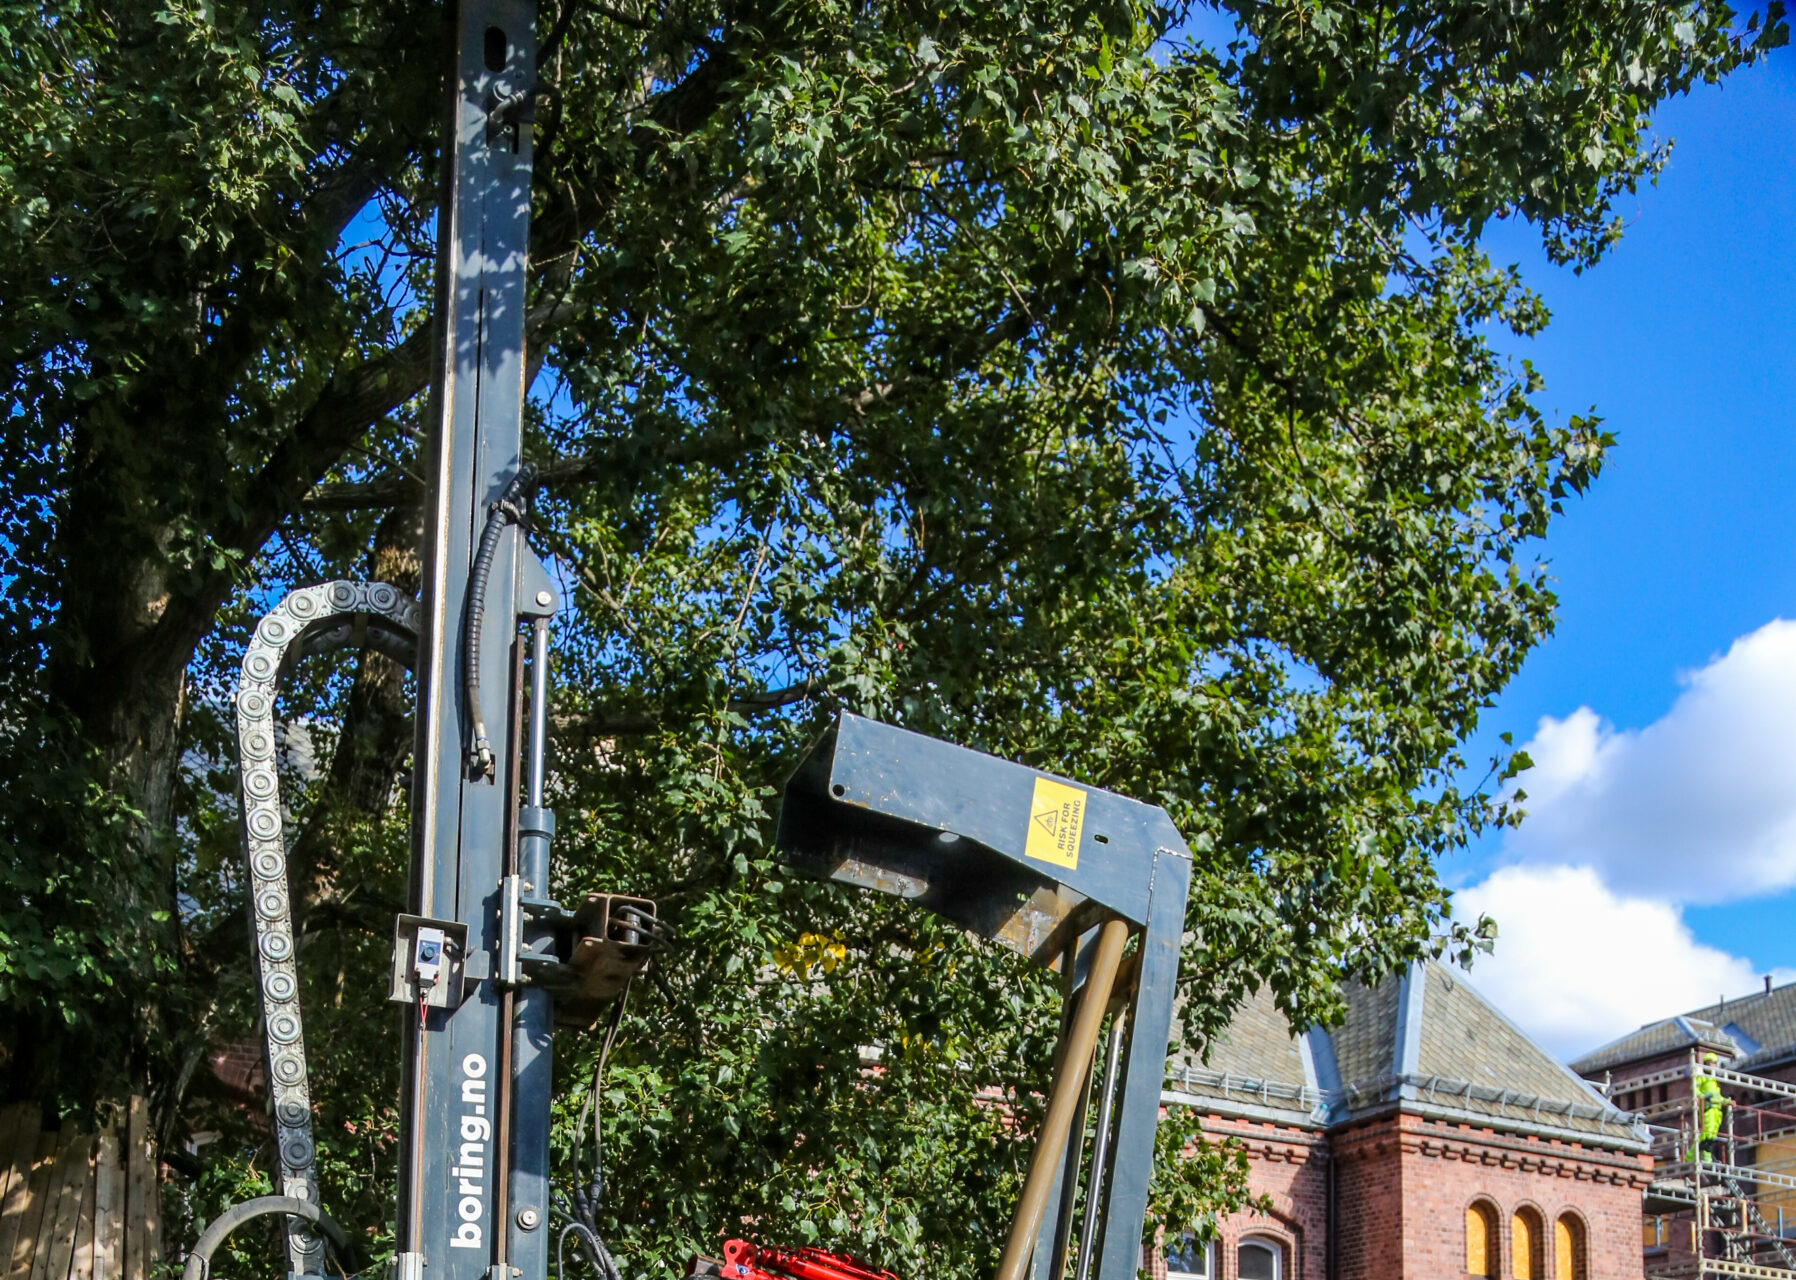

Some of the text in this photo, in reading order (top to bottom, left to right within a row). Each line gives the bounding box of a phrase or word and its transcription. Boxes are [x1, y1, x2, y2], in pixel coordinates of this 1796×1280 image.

[1057, 802, 1071, 850] RISK FOR
[1066, 800, 1081, 858] SQUEEZING
[450, 1053, 491, 1249] boring.no
